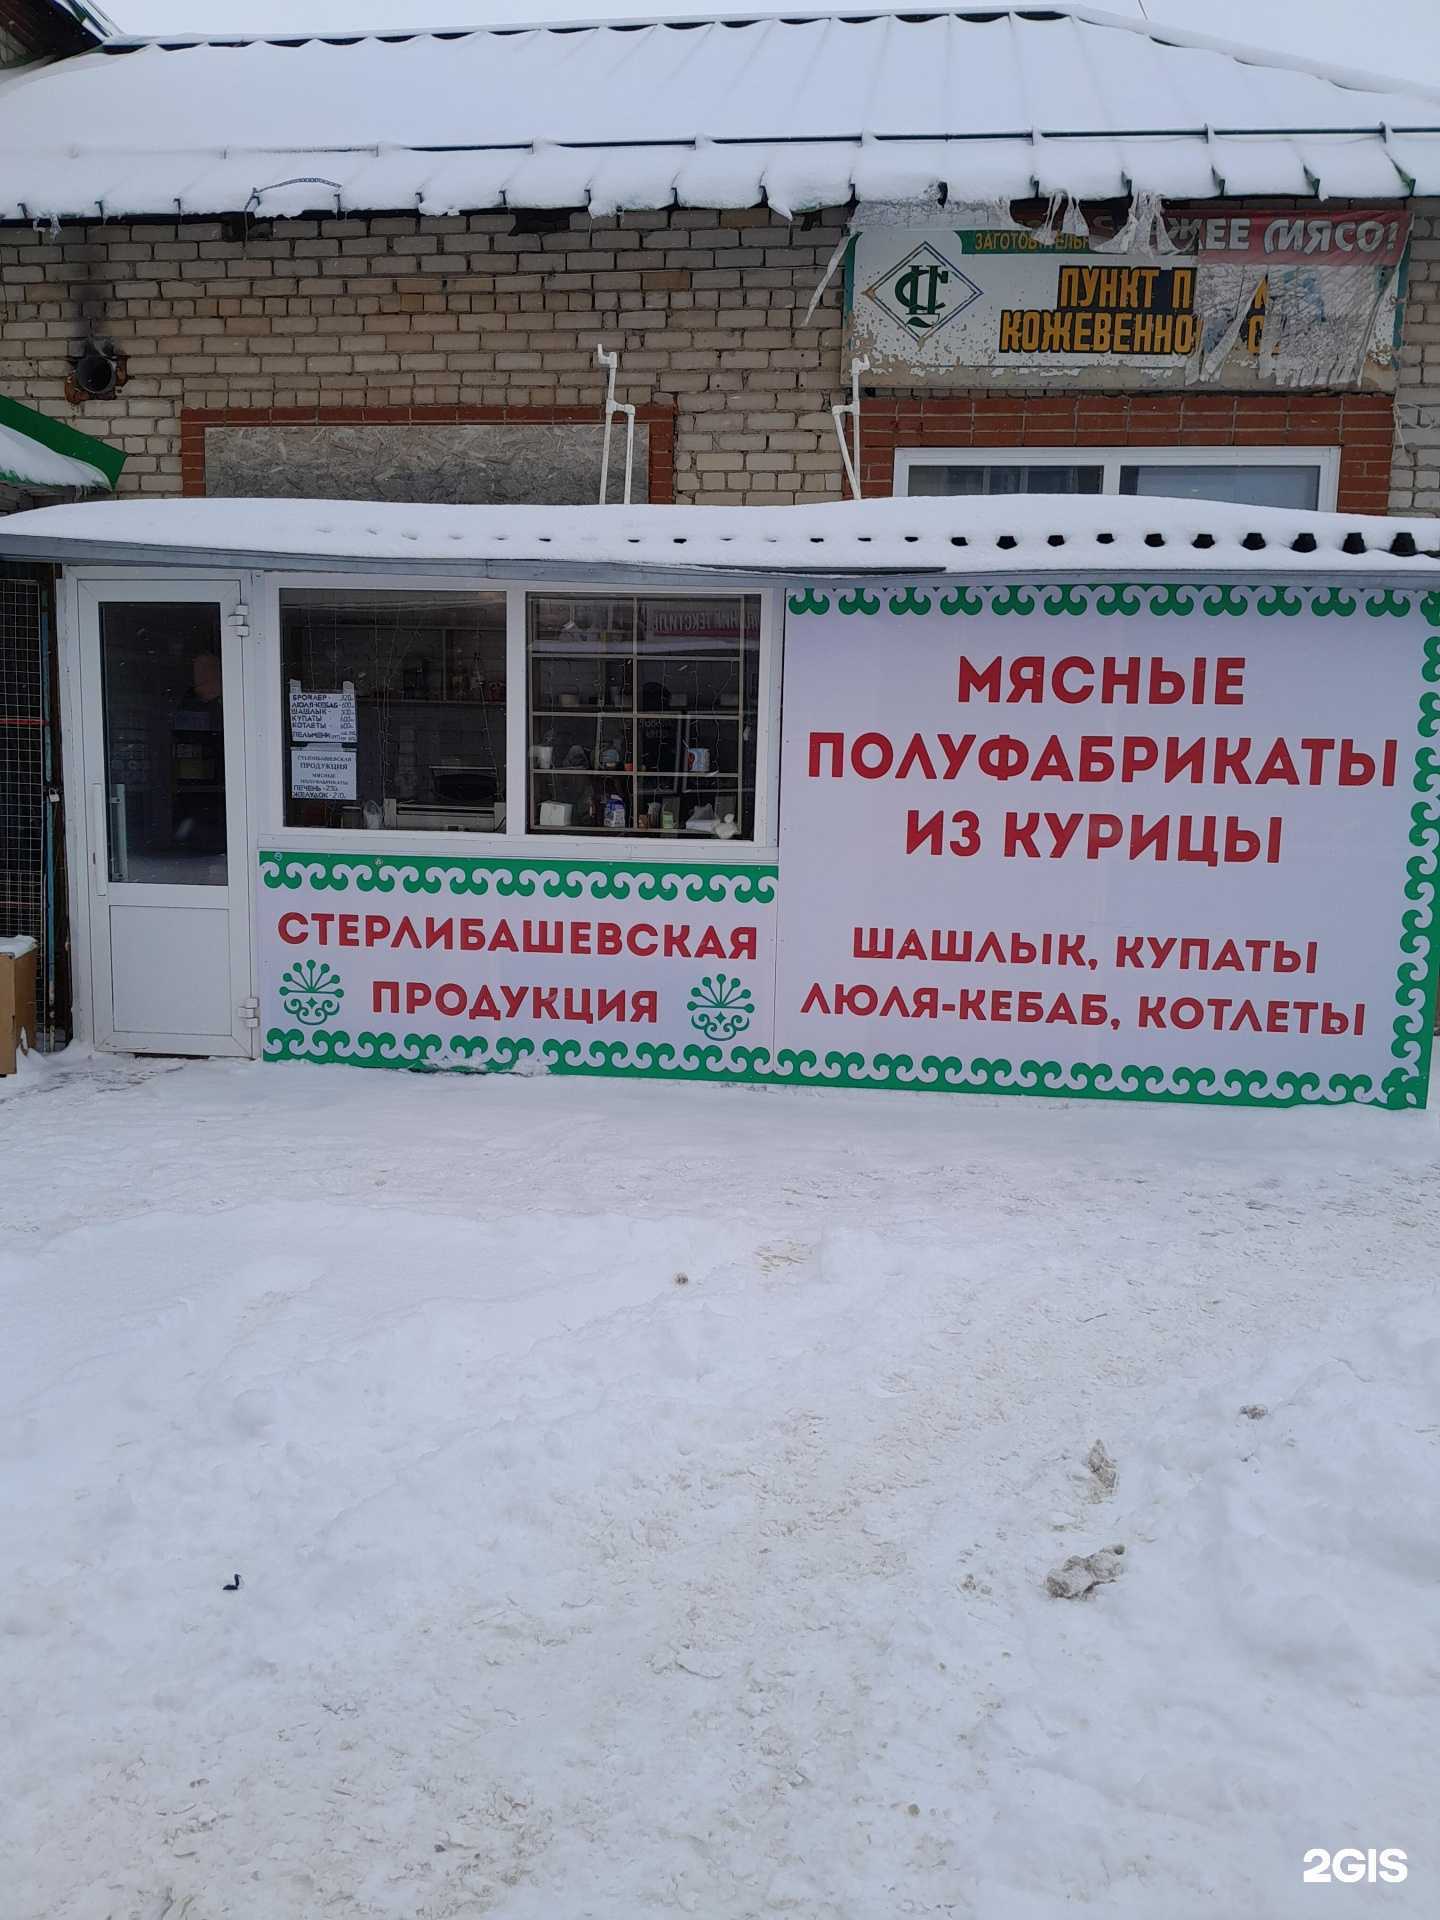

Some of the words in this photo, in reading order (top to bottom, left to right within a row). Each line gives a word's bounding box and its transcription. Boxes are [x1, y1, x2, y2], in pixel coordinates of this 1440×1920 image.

[1059, 267, 1160, 309] ПУНКТ
[959, 656, 1245, 705] МЯСНЫЕ
[809, 732, 1397, 786] ПОЛУФАБРИКАТЫ
[906, 810, 981, 858] ИЗ
[1003, 812, 1282, 868] КУРИЦЫ
[278, 912, 757, 961] СТЕРЛИБАШЕВСКАЯ
[853, 927, 1098, 970] ШАШЛЫК,
[1115, 937, 1317, 975] КУПАТЫ
[372, 981, 657, 1025] ПРОДУКЦИЯ
[800, 983, 1120, 1031] ЛЮЛЯ-КЕБАБ,
[1138, 997, 1365, 1036] КОТЛЕТЫ
